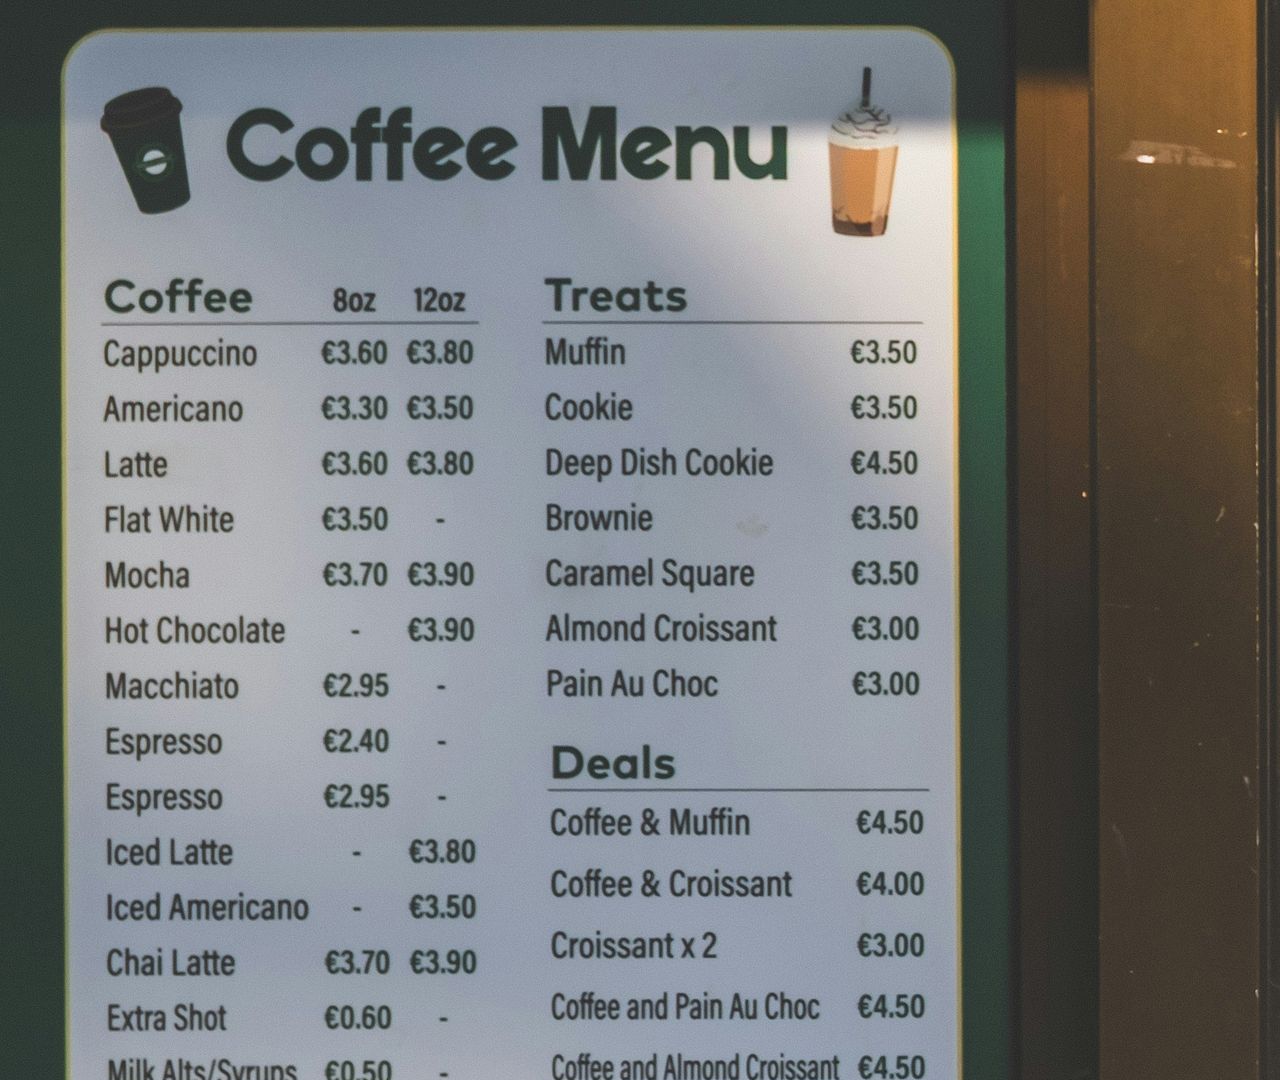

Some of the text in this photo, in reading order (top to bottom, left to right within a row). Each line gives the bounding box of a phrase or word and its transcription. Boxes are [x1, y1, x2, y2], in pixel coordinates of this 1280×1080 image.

[225, 105, 789, 183] Coffee Menu
[104, 277, 466, 314] Coffee 8oz 12oz
[544, 278, 687, 312] Treats
[104, 337, 473, 373] Cappuccino €3.60 €3.80
[546, 336, 917, 365] Muffin €3.50
[104, 394, 473, 422] Americano €3.30 €3.50
[545, 392, 917, 421] Cookie €3.50
[105, 451, 473, 478] Latte €3.60 €3.80
[546, 447, 918, 482] Deep Dish Cookie €4.50
[105, 505, 388, 533] Flat White €3.50
[547, 503, 918, 531] Brownie €3.50
[106, 560, 474, 589] Mocha €3.70 €3.90
[546, 558, 918, 593] Caramel Square €3.50
[106, 616, 474, 644] Hot Chocolate €3.90
[546, 613, 919, 642] Almond Croissant €3.00
[106, 671, 389, 699] Macchiato €2.95
[548, 669, 919, 697] Pain Au Choc €3.00
[106, 727, 389, 761] Espresso €2.40
[552, 744, 676, 780] Deals
[107, 783, 389, 817] Espresso €2.95
[551, 807, 923, 836] Coffee Muffin €4.50
[107, 837, 476, 866] Iced Latte €3.80
[551, 869, 924, 897] Coffee Croissant €4.00
[107, 892, 476, 921] Iced Americano €3.50
[552, 931, 924, 959] Croissant 2 €3.00
[107, 948, 476, 976] Chai Latte €3.70 €3.90
[108, 1003, 391, 1031] Extra Shot €0.60
[552, 992, 925, 1020] Coffee and Pain Au Choc €4.50
[552, 1053, 925, 1080] Coffee and Almond Croissant €4.50
